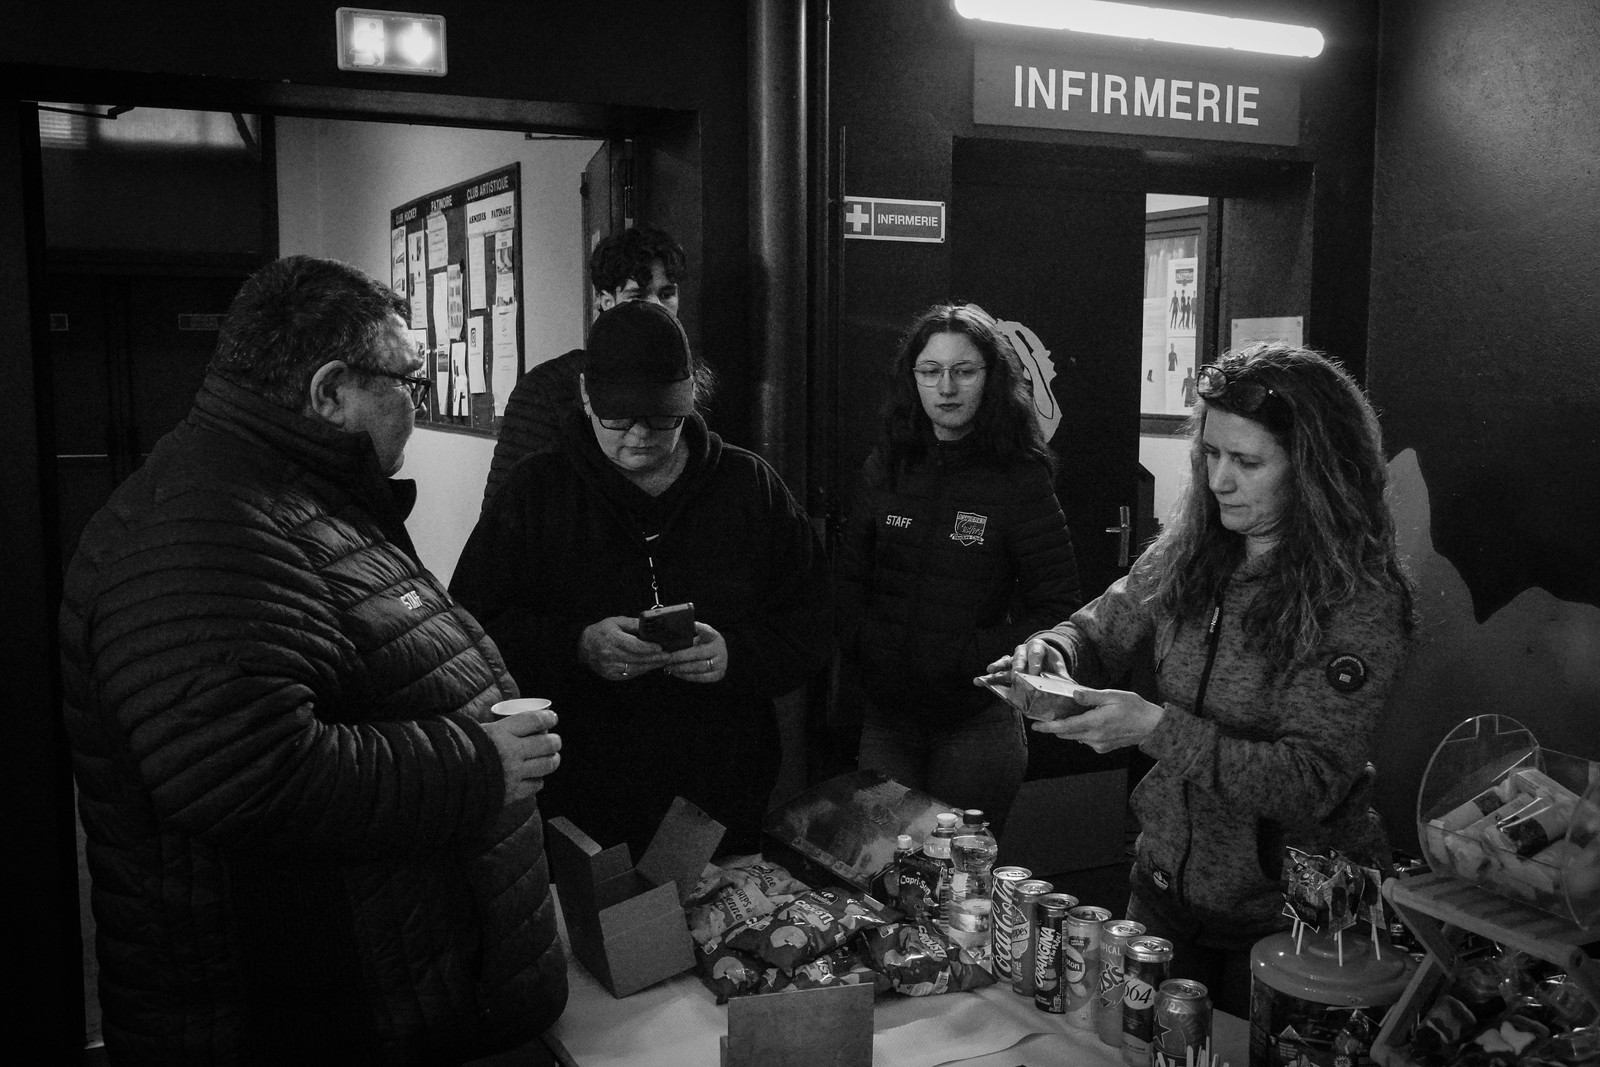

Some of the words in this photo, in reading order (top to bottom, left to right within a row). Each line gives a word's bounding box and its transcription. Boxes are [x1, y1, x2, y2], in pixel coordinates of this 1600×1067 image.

[1014, 65, 1260, 126] INFIRMERIE
[466, 186, 478, 201] CLUB
[480, 175, 509, 196] ARTISTIQUE
[877, 213, 938, 227] INFIRMERIE
[885, 514, 913, 529] STAFF
[900, 874, 931, 895] Capri-Sun
[735, 888, 752, 908] CHIPS
[1035, 926, 1056, 989] ORANGINA
